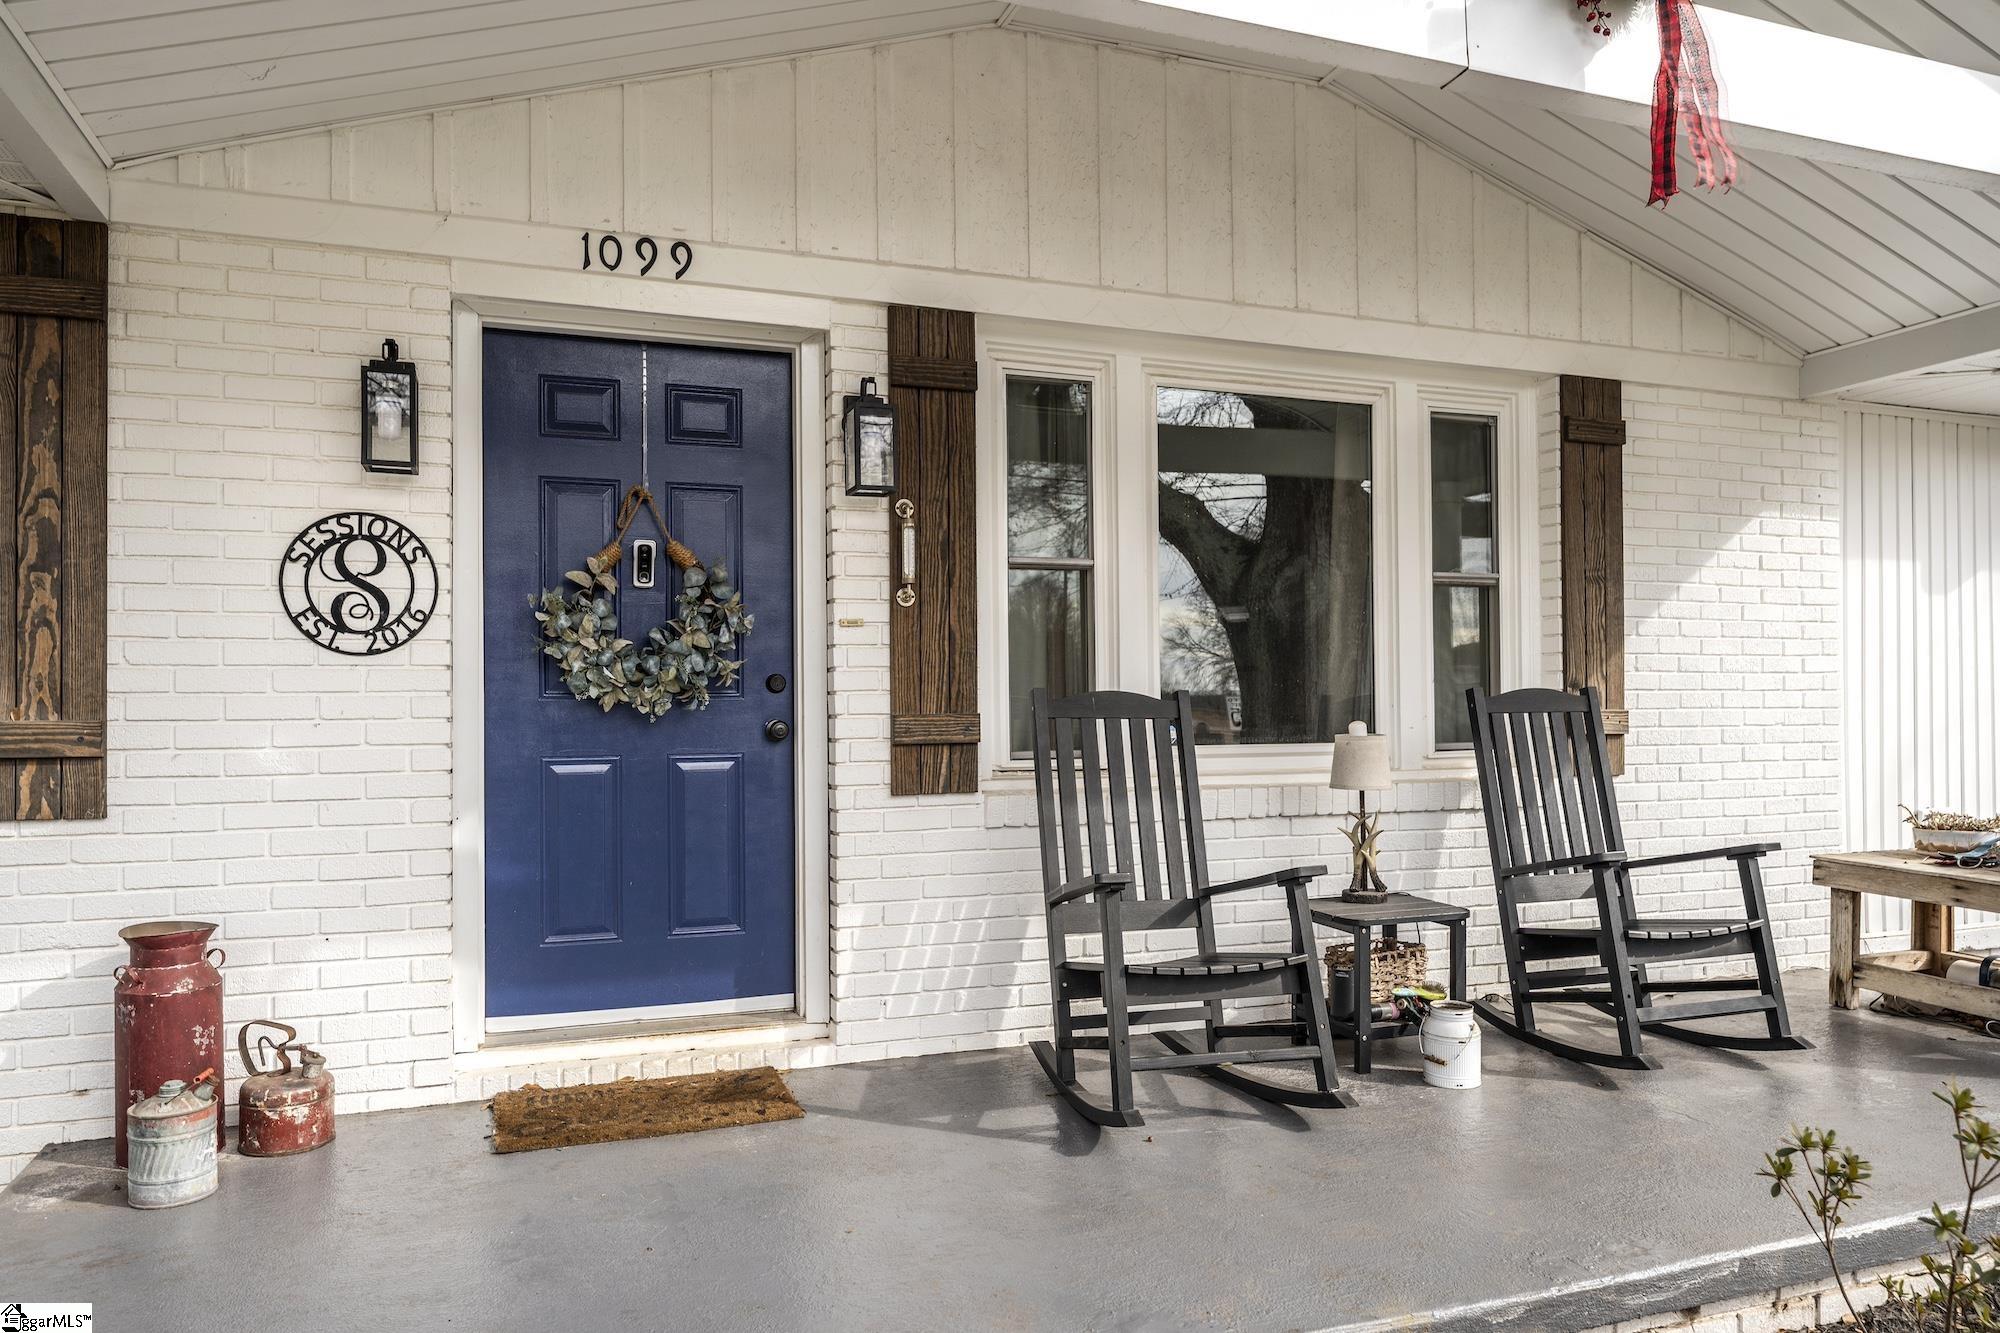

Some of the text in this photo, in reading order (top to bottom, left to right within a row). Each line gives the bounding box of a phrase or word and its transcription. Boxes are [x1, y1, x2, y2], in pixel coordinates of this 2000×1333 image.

[581, 232, 693, 280] 1099
[287, 513, 427, 568] SESSIONS
[292, 606, 427, 653] EST. 2016
